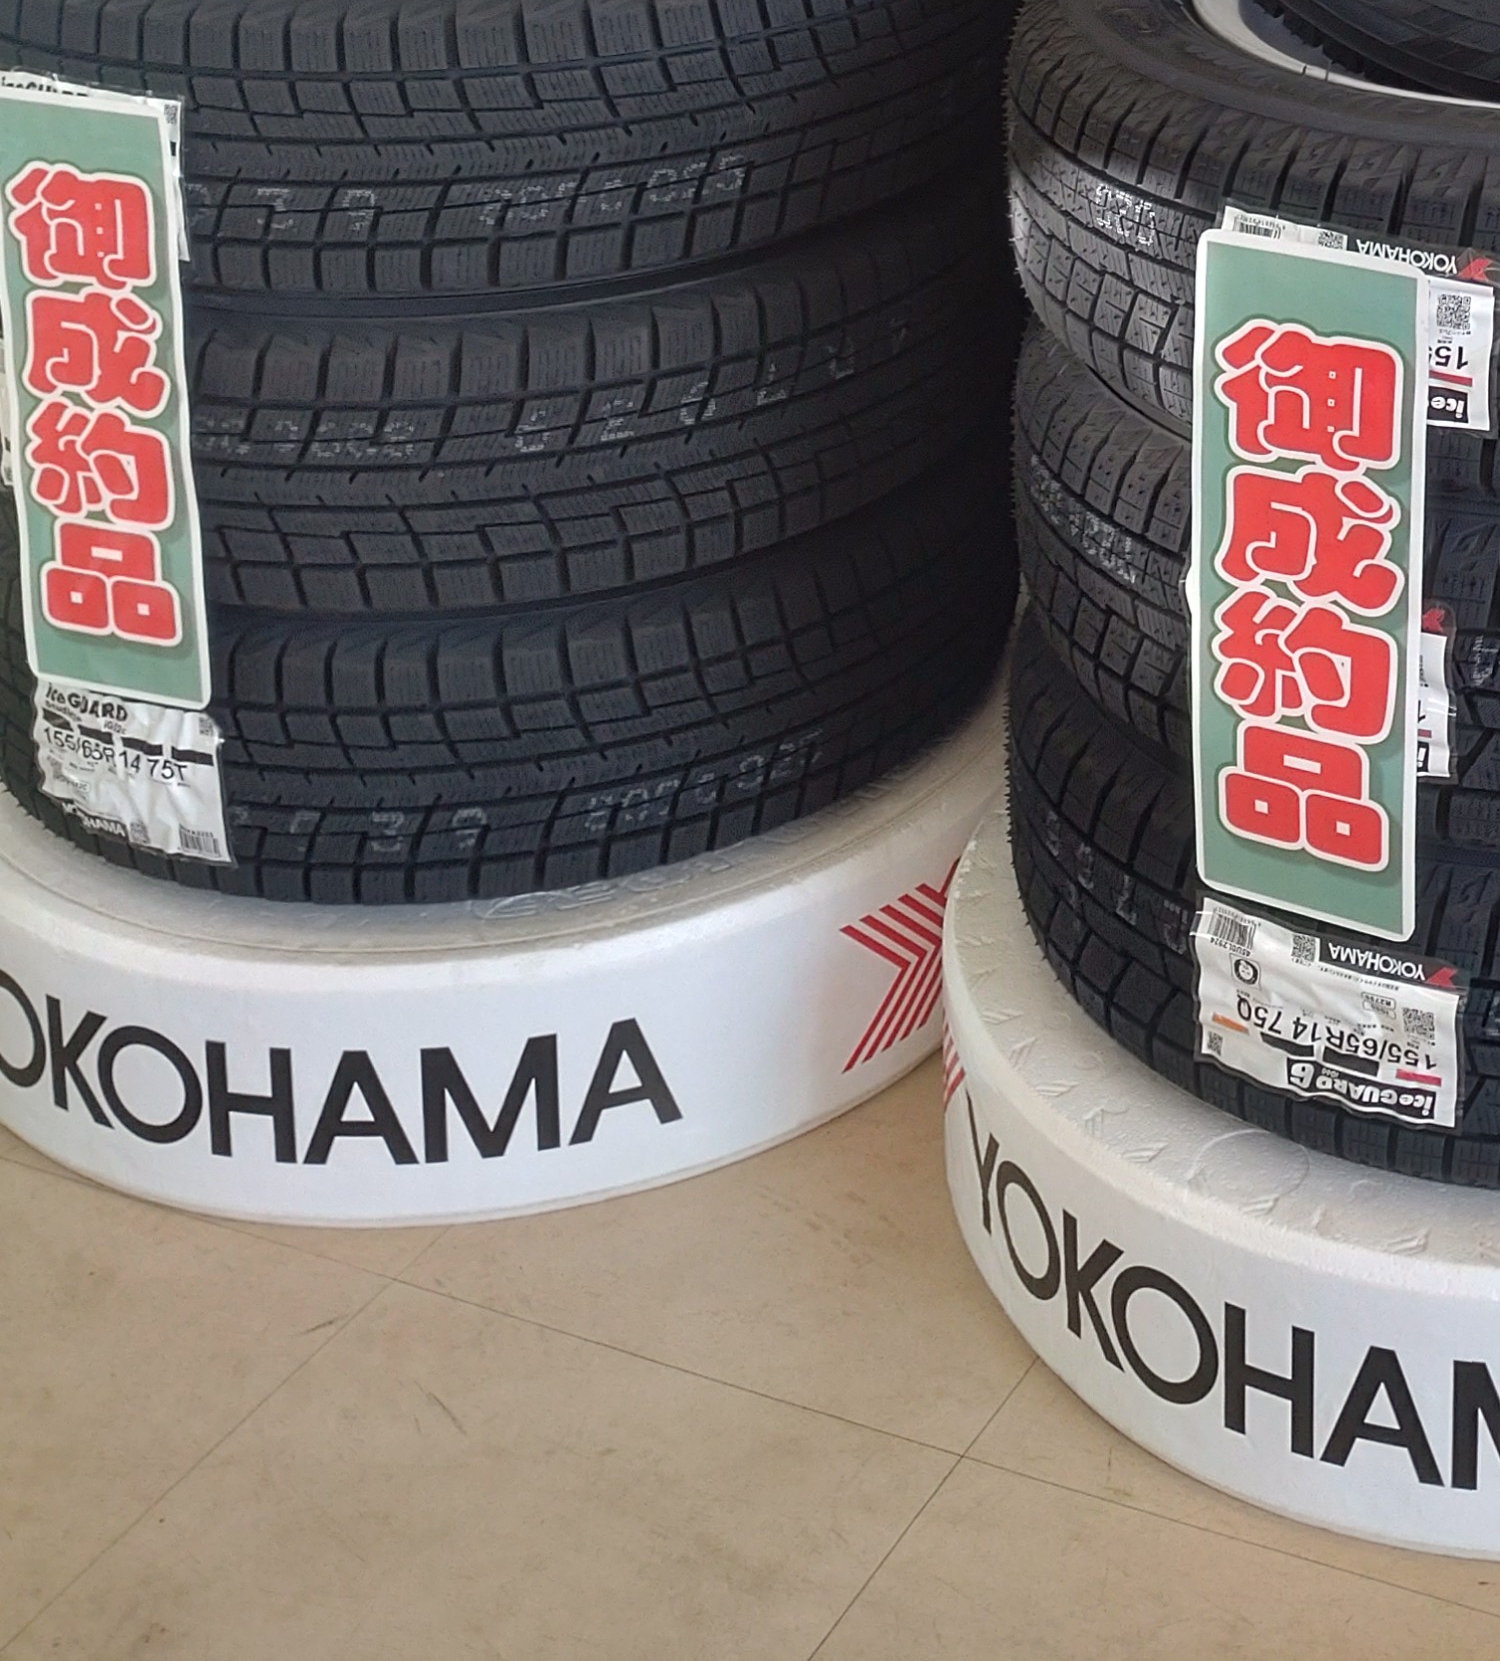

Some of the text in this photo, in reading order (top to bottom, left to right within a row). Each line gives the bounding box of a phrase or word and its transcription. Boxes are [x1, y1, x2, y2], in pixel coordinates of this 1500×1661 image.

[1355, 238, 1458, 275] YOKOHAMA
[6, 160, 182, 647] 御成約品
[1213, 319, 1406, 872] 御成約品
[1328, 941, 1428, 981] YOKOHAMA
[1235, 994, 1282, 1034] 75Q
[1292, 1017, 1438, 1071] 155/65R14
[1289, 1061, 1436, 1118] 6 iceGUARD
